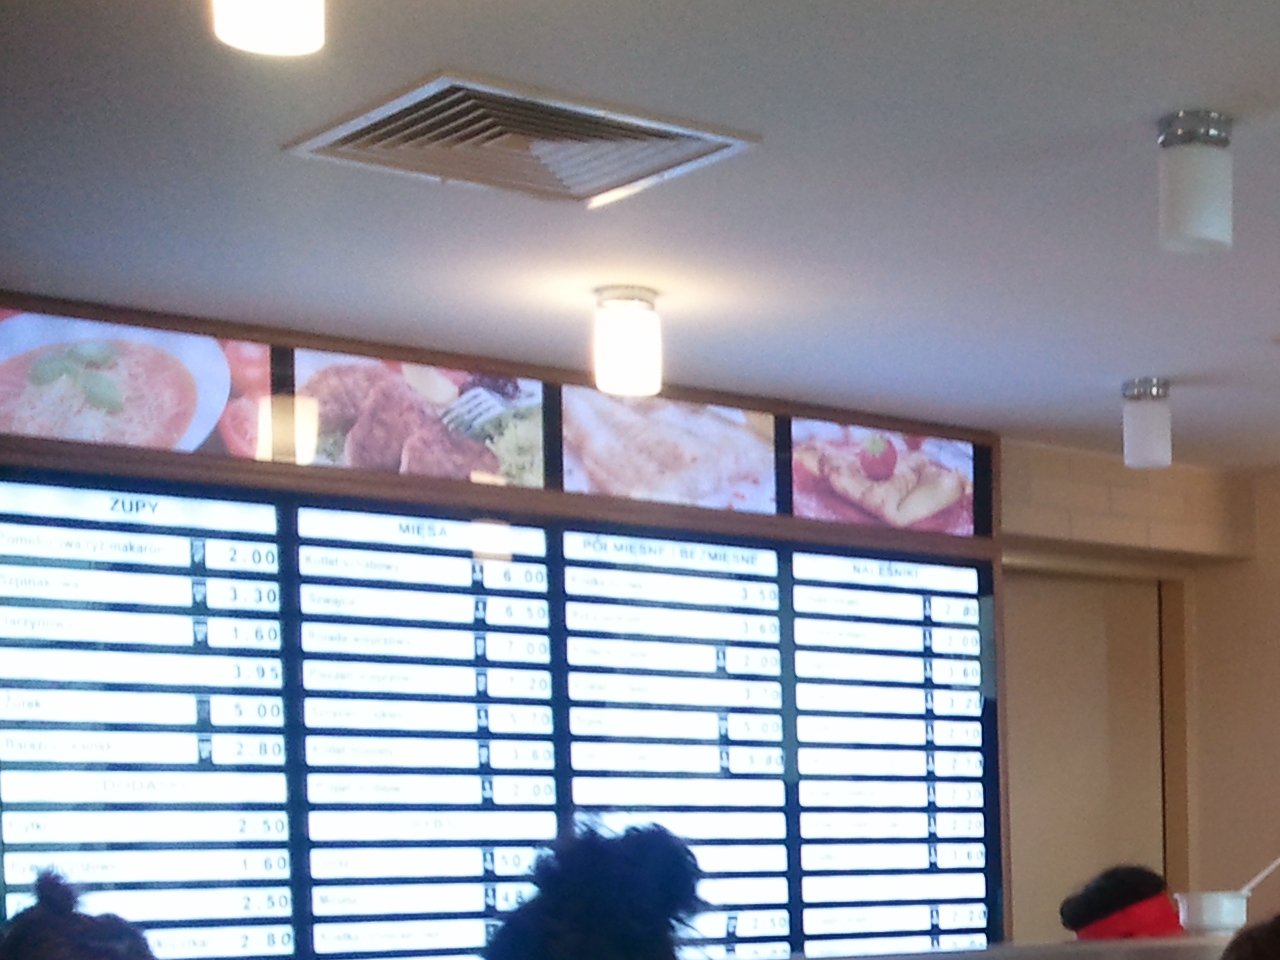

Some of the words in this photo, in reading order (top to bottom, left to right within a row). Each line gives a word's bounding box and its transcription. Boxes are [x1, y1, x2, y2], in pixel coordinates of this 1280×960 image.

[110, 497, 158, 514] ZUPY
[228, 547, 276, 565] 2.00
[503, 568, 546, 584] 600
